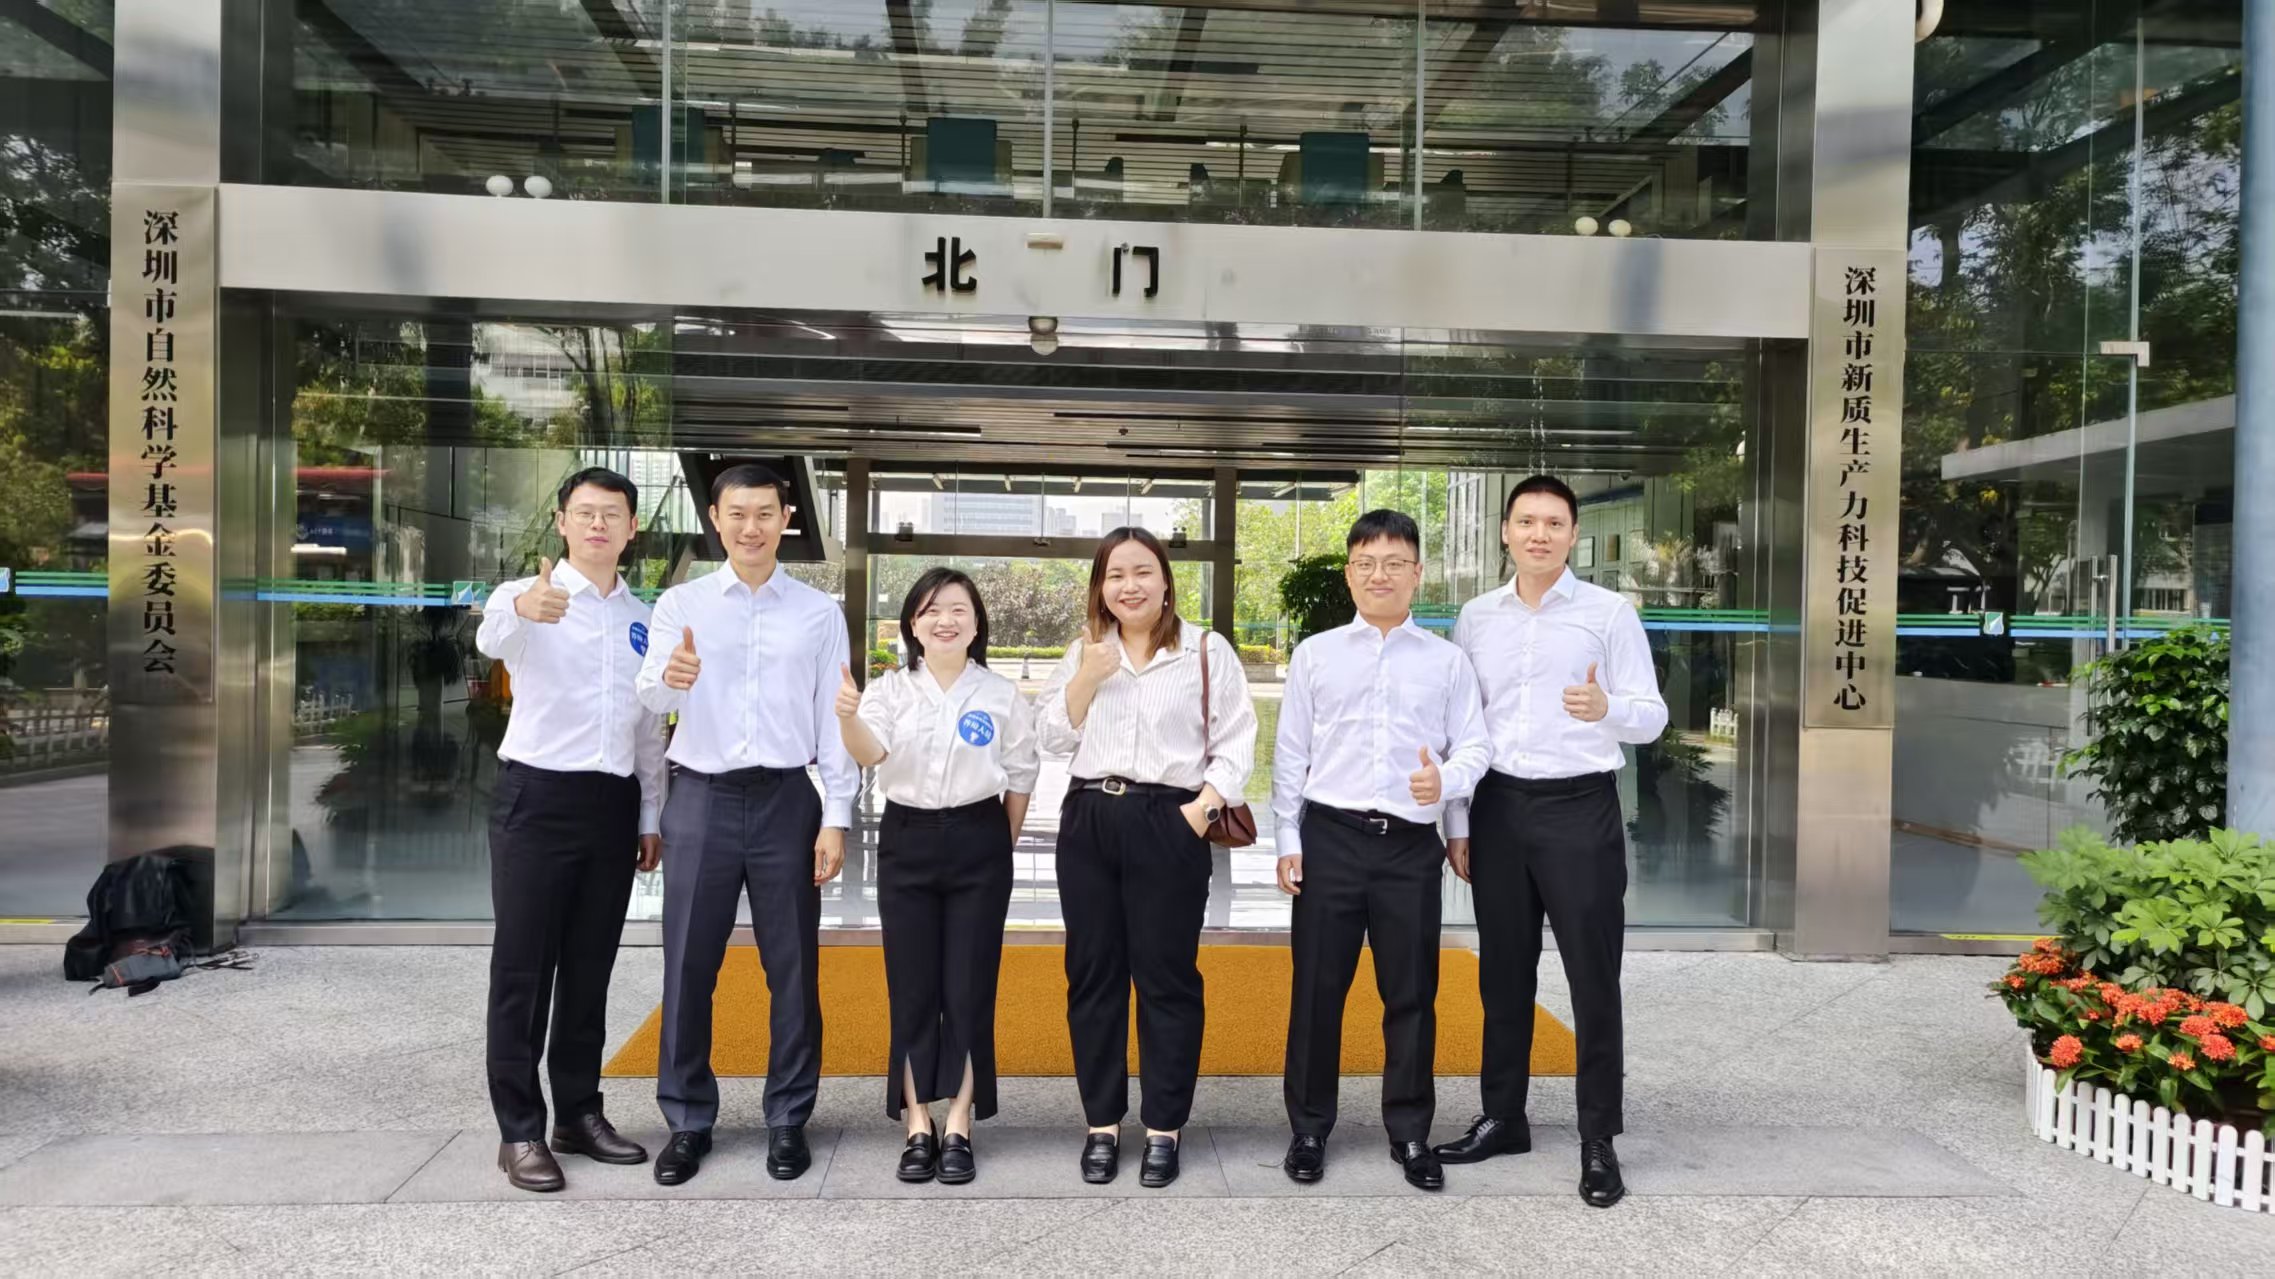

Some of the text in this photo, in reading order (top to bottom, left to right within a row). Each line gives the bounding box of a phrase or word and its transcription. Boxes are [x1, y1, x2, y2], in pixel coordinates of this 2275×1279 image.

[141, 209, 178, 674] 深圳市自然科学基金委员会
[1833, 266, 1875, 711] 深圳市新质生产力科技促进中心
